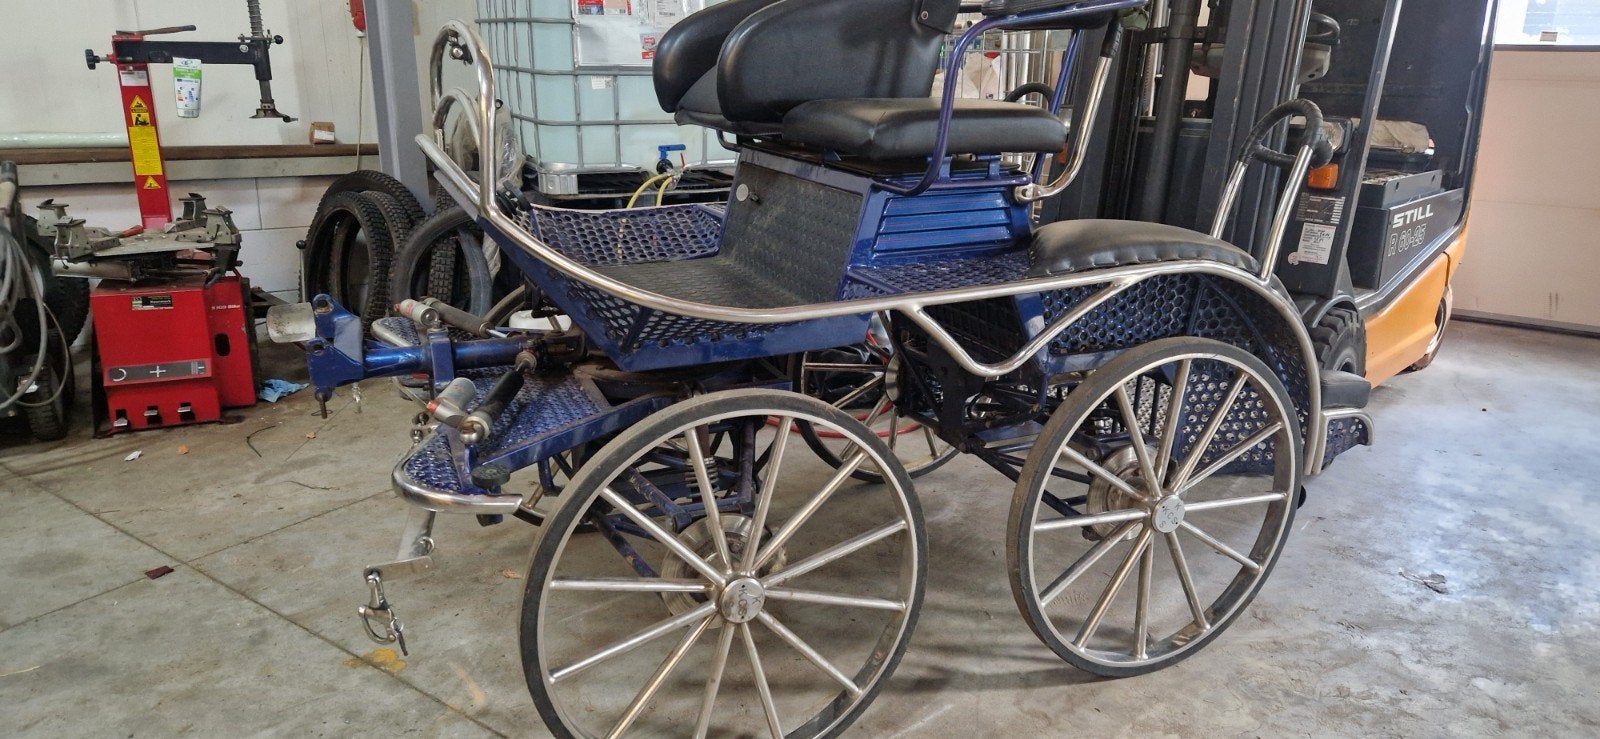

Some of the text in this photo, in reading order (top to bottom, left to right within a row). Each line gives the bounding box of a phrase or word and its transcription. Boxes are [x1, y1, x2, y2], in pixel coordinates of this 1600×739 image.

[1392, 204, 1434, 229] STILL
[1387, 223, 1427, 257] R 60-25
